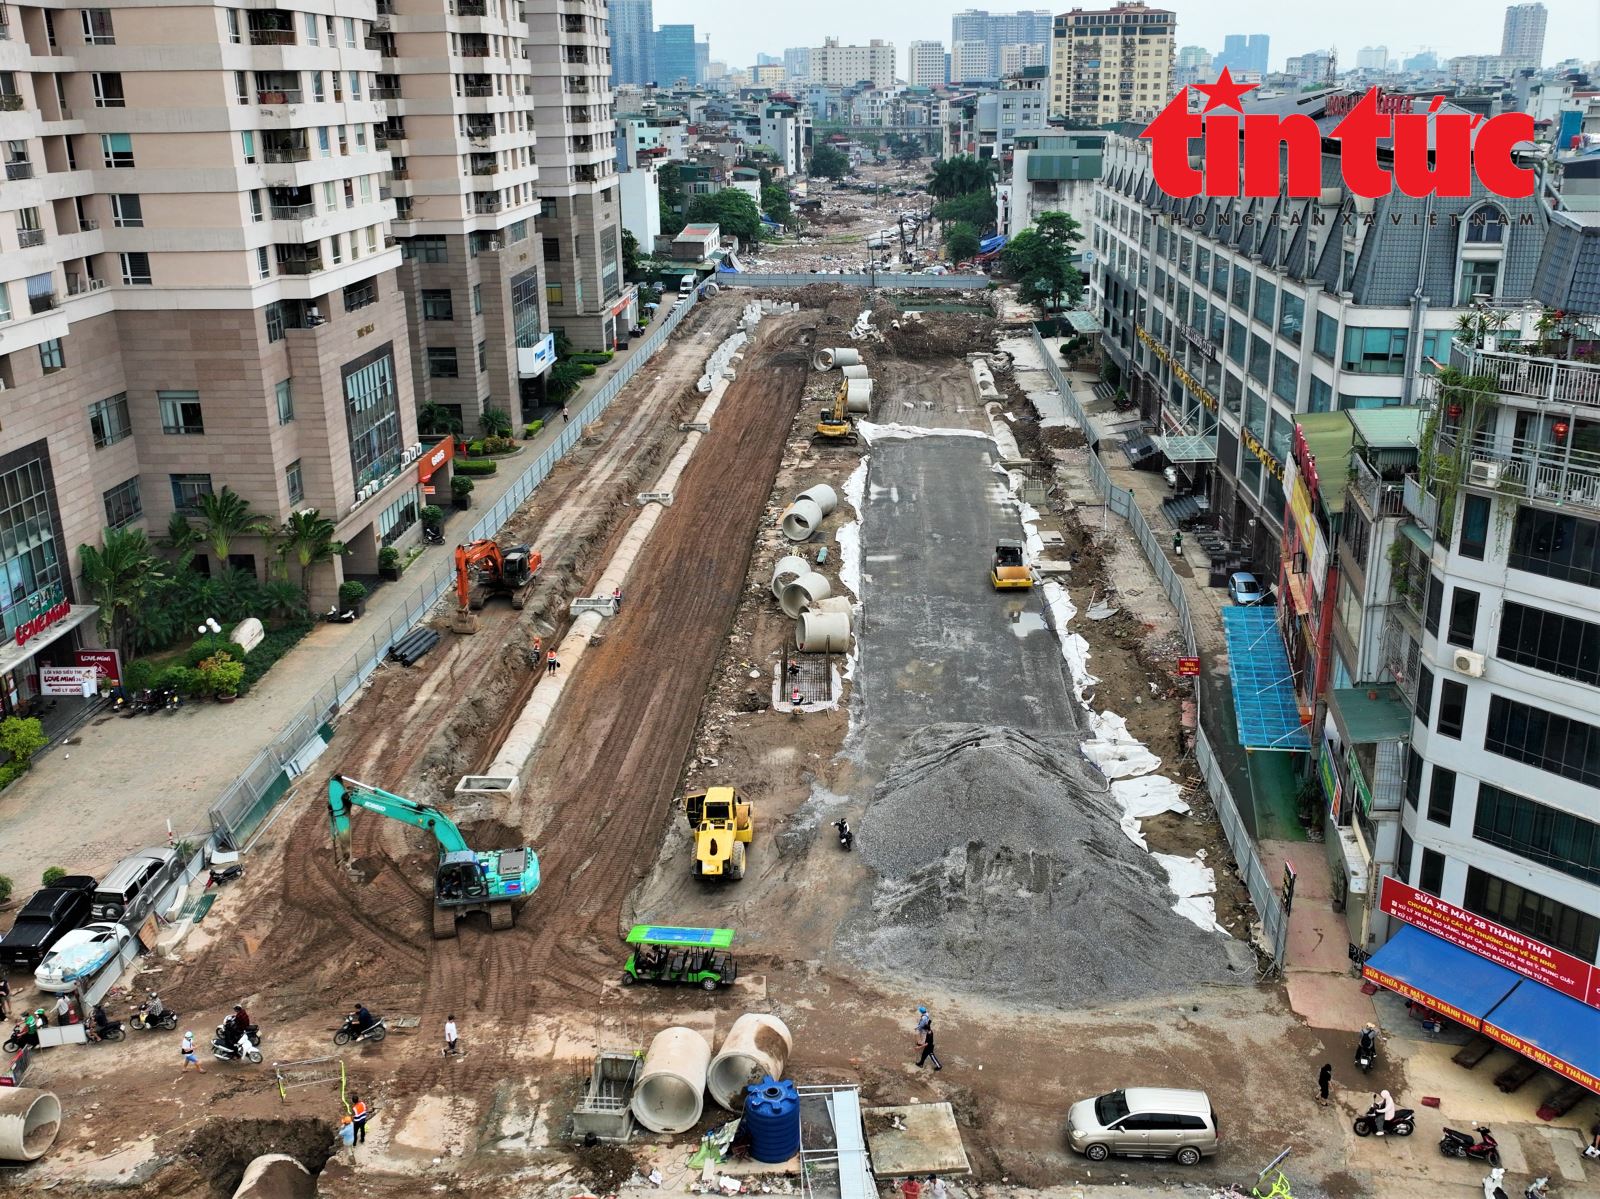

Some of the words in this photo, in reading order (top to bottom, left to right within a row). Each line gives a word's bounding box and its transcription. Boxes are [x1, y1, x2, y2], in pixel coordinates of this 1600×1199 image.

[1397, 911, 1406, 919] XỬ
[1415, 919, 1428, 929] SỬA
[1428, 924, 1445, 937] CHỮA
[1445, 932, 1458, 943] CÁC
[1458, 939, 1466, 947] XE
[1477, 948, 1492, 958] CAO
[1492, 953, 1506, 964] BÁO
[1506, 959, 1517, 970] LỖI
[1517, 964, 1534, 977] ĐIỆN
[1534, 971, 1543, 980] TỬ
[1398, 903, 1407, 911] XỬ
[1406, 906, 1414, 914] LÝ
[1423, 913, 1430, 921] ĐI
[1429, 917, 1443, 927] HAO
[1485, 941, 1498, 952] SỬA
[1498, 948, 1516, 960] CHỮA
[1517, 956, 1527, 964] XE
[1540, 966, 1559, 979] RUNG
[1559, 974, 1575, 986] GIẬT
[1407, 900, 1432, 915] CHUYÊN
[1433, 910, 1442, 919] XỬ
[1443, 913, 1450, 922] LÝ
[1451, 918, 1464, 929] CÁC
[1464, 924, 1475, 934] LỖI
[1476, 930, 1504, 946] THƯỜNG
[1504, 942, 1519, 953] GẶP
[1519, 948, 1529, 957] VỀ
[1529, 953, 1539, 962] XE
[1414, 892, 1434, 907] SỬA
[1436, 902, 1449, 913] XE
[1450, 907, 1472, 923] MÁY
[1474, 919, 1486, 930] 28
[1489, 925, 1524, 946] THÀNH
[1527, 941, 1552, 958] THÁI
[1365, 968, 1379, 980] SỬA
[1380, 973, 1397, 988] CHỮA
[1399, 983, 1409, 992] XE
[1410, 988, 1425, 1000] MÁY
[1427, 997, 1436, 1006] 28
[1437, 1002, 1461, 1020] THÀNH
[1462, 1014, 1479, 1028] THÁI
[1484, 1024, 1499, 1038] SỬA
[1500, 1033, 1521, 1049] CHỮA
[1522, 1044, 1533, 1055] XE
[1534, 1050, 1552, 1064] MÁY
[1553, 1060, 1564, 1071] 28
[1565, 1065, 1593, 1086] THÀNH
